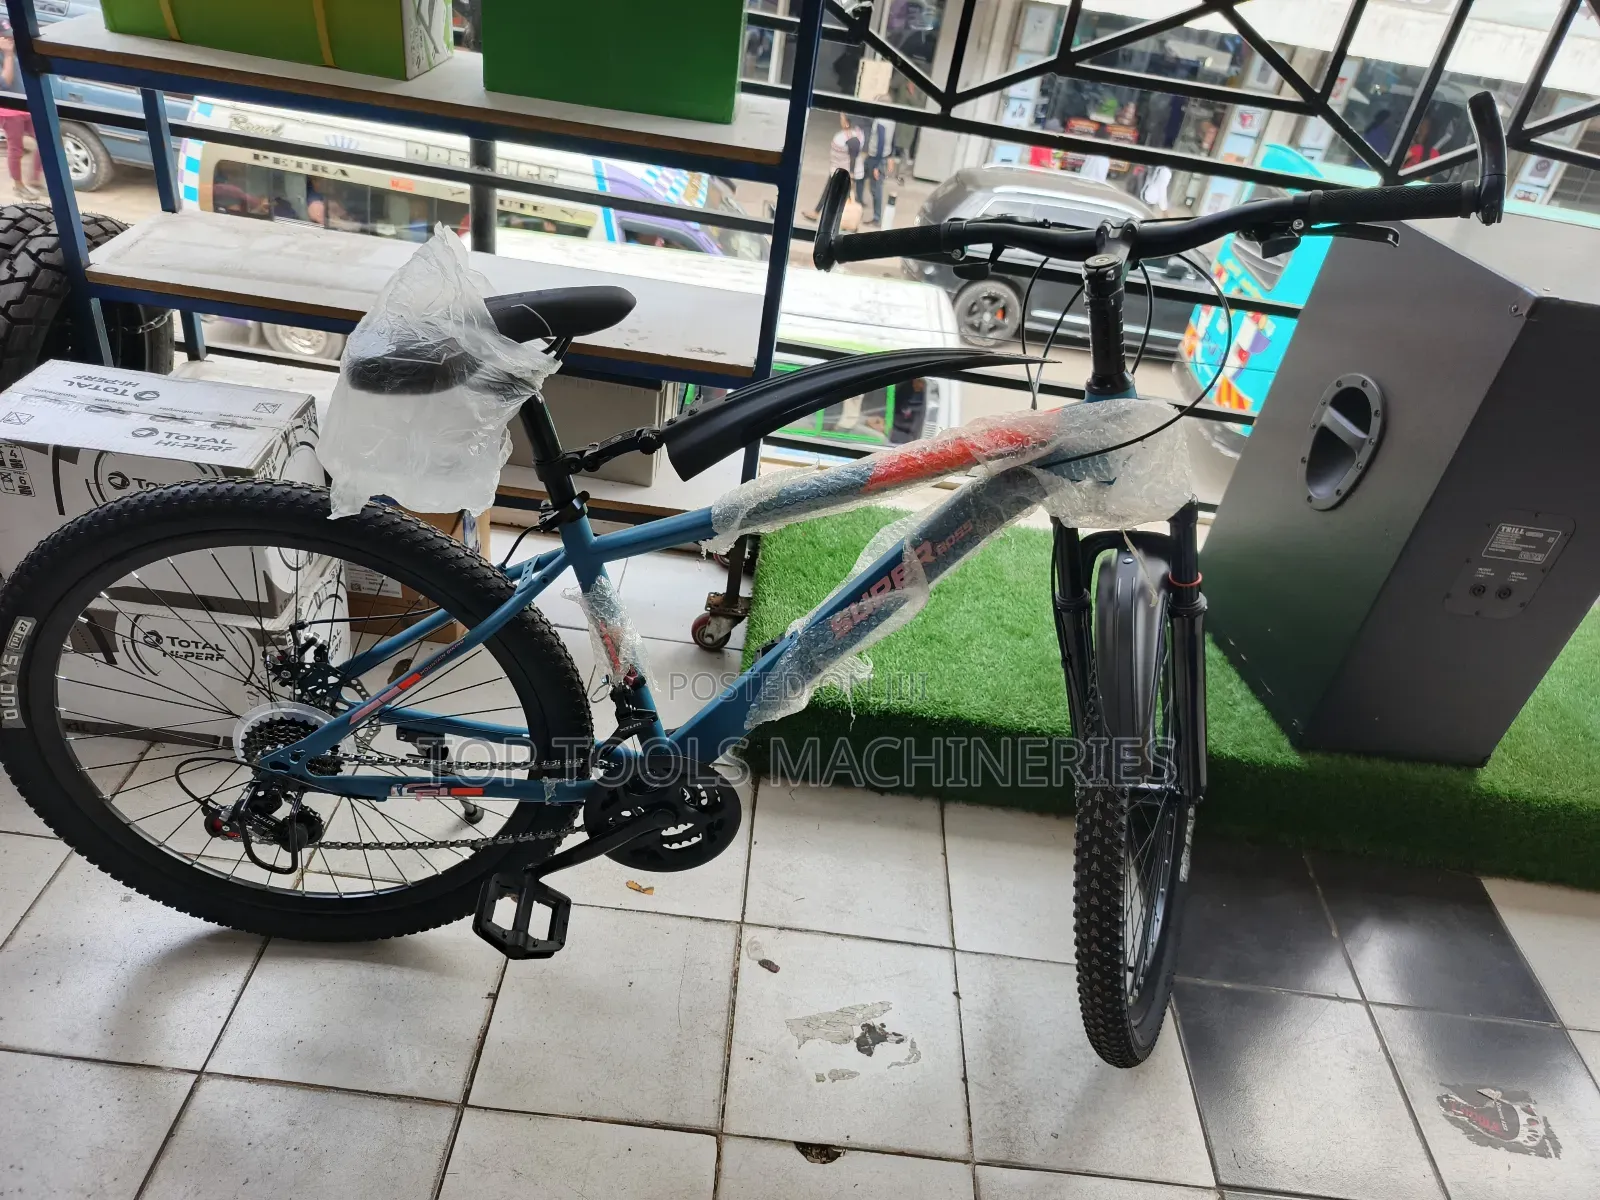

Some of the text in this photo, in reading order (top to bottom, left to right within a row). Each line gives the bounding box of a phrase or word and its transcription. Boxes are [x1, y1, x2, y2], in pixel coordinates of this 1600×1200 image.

[253, 153, 349, 177] PETRA
[63, 379, 130, 397] TOTAL
[164, 431, 233, 445] TOTAL
[19, 476, 26, 485] 6
[936, 520, 974, 556] BOSS
[1501, 526, 1525, 534] TRILL
[831, 541, 937, 640] SUPER
[11, 634, 22, 647] TPI
[19, 621, 28, 632] 27
[166, 636, 226, 652] TOTAL
